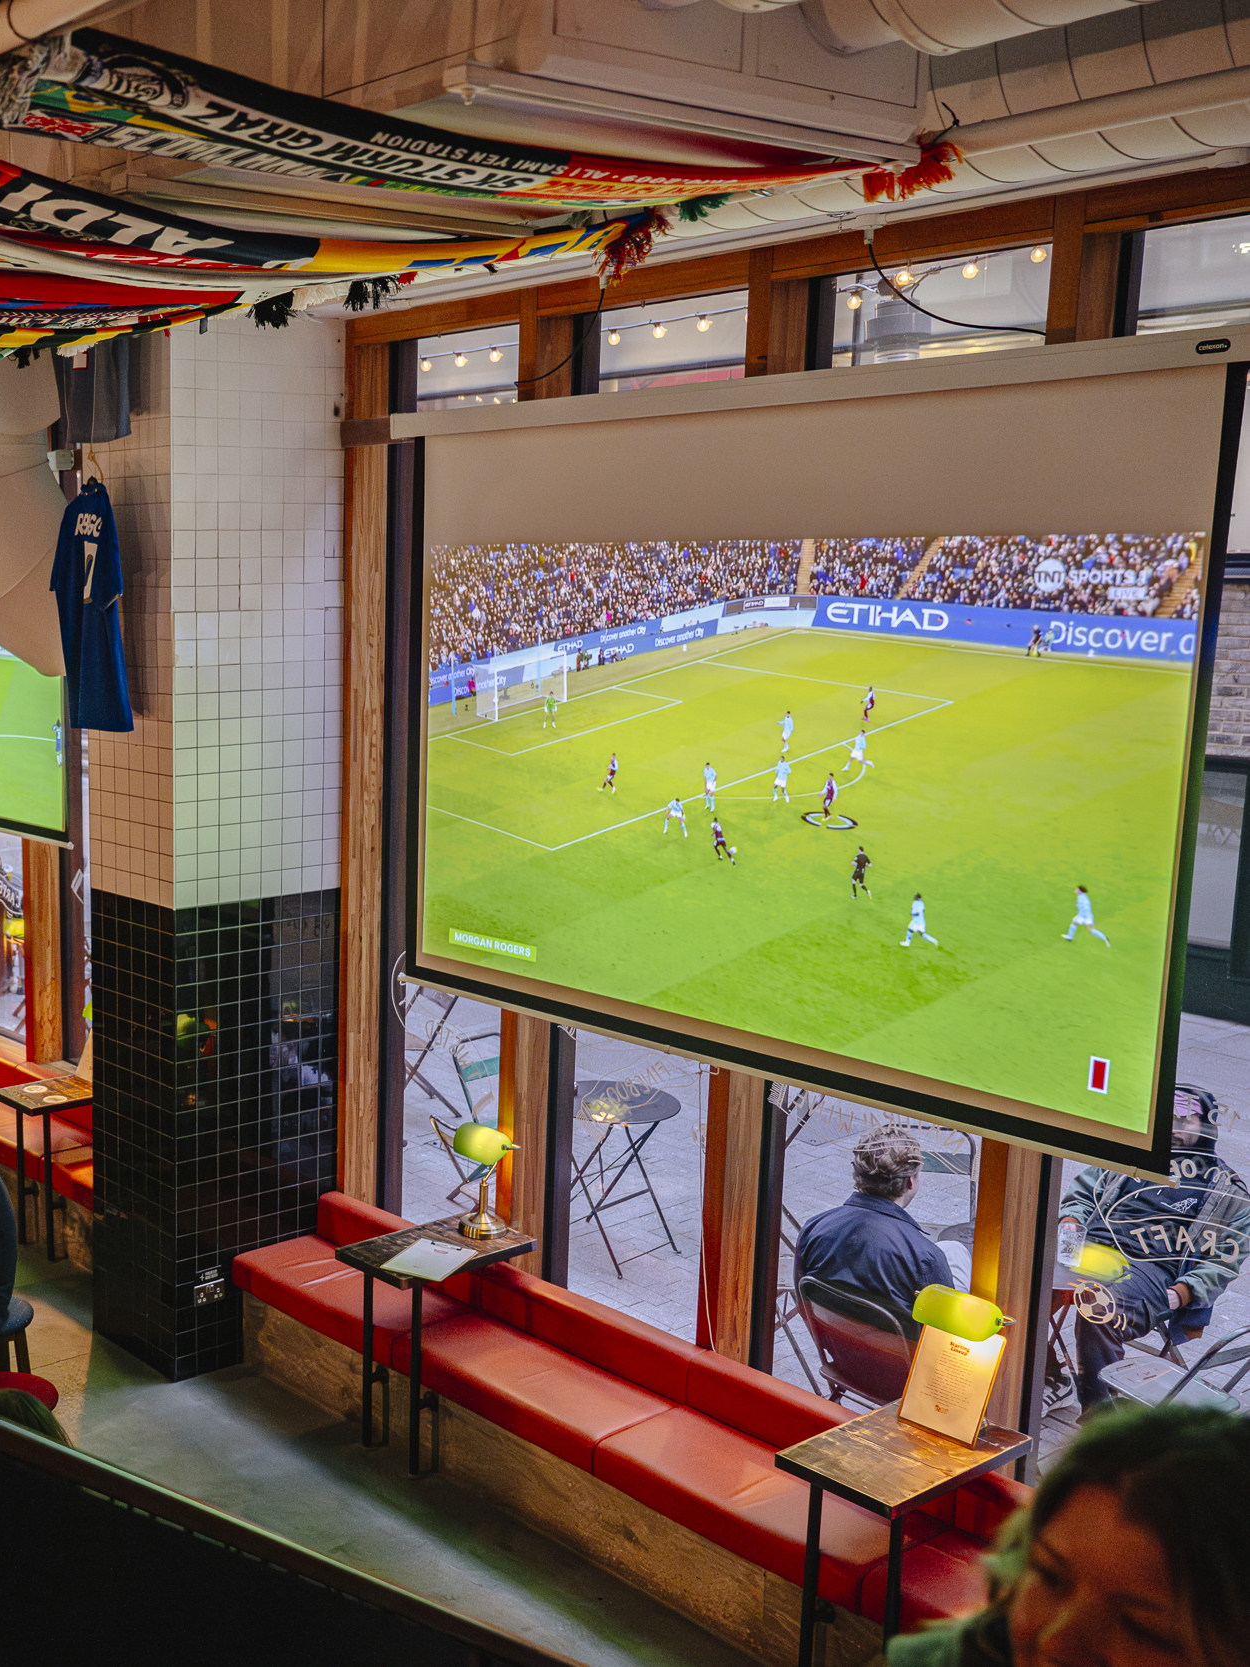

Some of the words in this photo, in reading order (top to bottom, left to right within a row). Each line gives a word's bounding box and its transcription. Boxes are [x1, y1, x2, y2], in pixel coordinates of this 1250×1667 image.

[183, 101, 323, 150] GRAZ
[370, 131, 468, 160] STADION
[310, 141, 476, 181] STURM
[467, 150, 507, 168] YEN
[512, 159, 569, 175] SAMI
[461, 172, 534, 189] SK
[569, 167, 610, 180] ALI
[1068, 569, 1136, 585] SPORTS
[1113, 589, 1140, 598] LIVE
[826, 602, 949, 631] ETIHAD
[655, 635, 676, 647] Discover
[677, 631, 695, 642] another
[694, 627, 705, 638] City
[1050, 621, 1173, 652] Discover
[454, 931, 492, 949] MORGAN
[494, 941, 531, 957] ROGERS
[949, 1341, 970, 1353] Starting
[950, 1347, 968, 1357] Lineup
